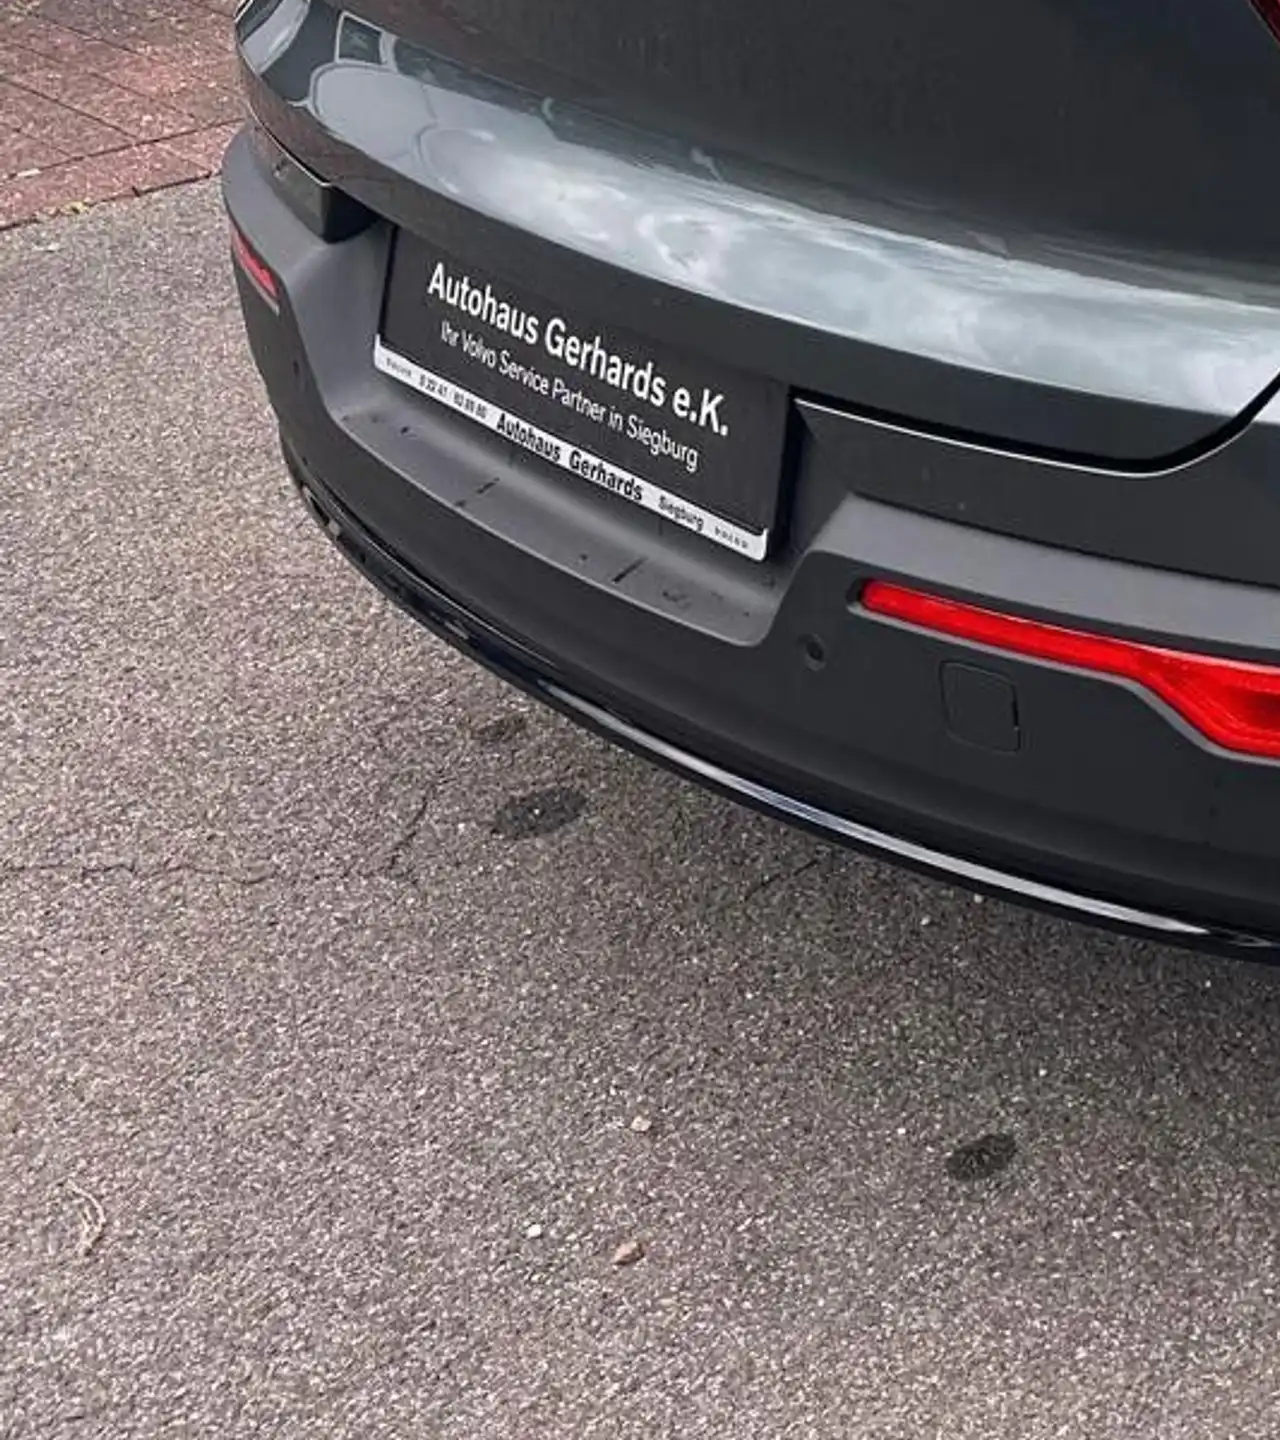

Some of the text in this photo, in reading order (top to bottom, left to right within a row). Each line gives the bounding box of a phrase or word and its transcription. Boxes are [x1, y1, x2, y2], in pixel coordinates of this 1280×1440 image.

[427, 262, 729, 437] Autohaus Gerhards e.K.
[461, 329, 497, 369] Volvo
[499, 349, 549, 396] Service
[552, 377, 607, 423] Partner
[607, 405, 624, 432] in
[626, 414, 699, 474] Siegburg
[496, 412, 562, 462] Autohaus
[568, 448, 643, 502] Gerhards
